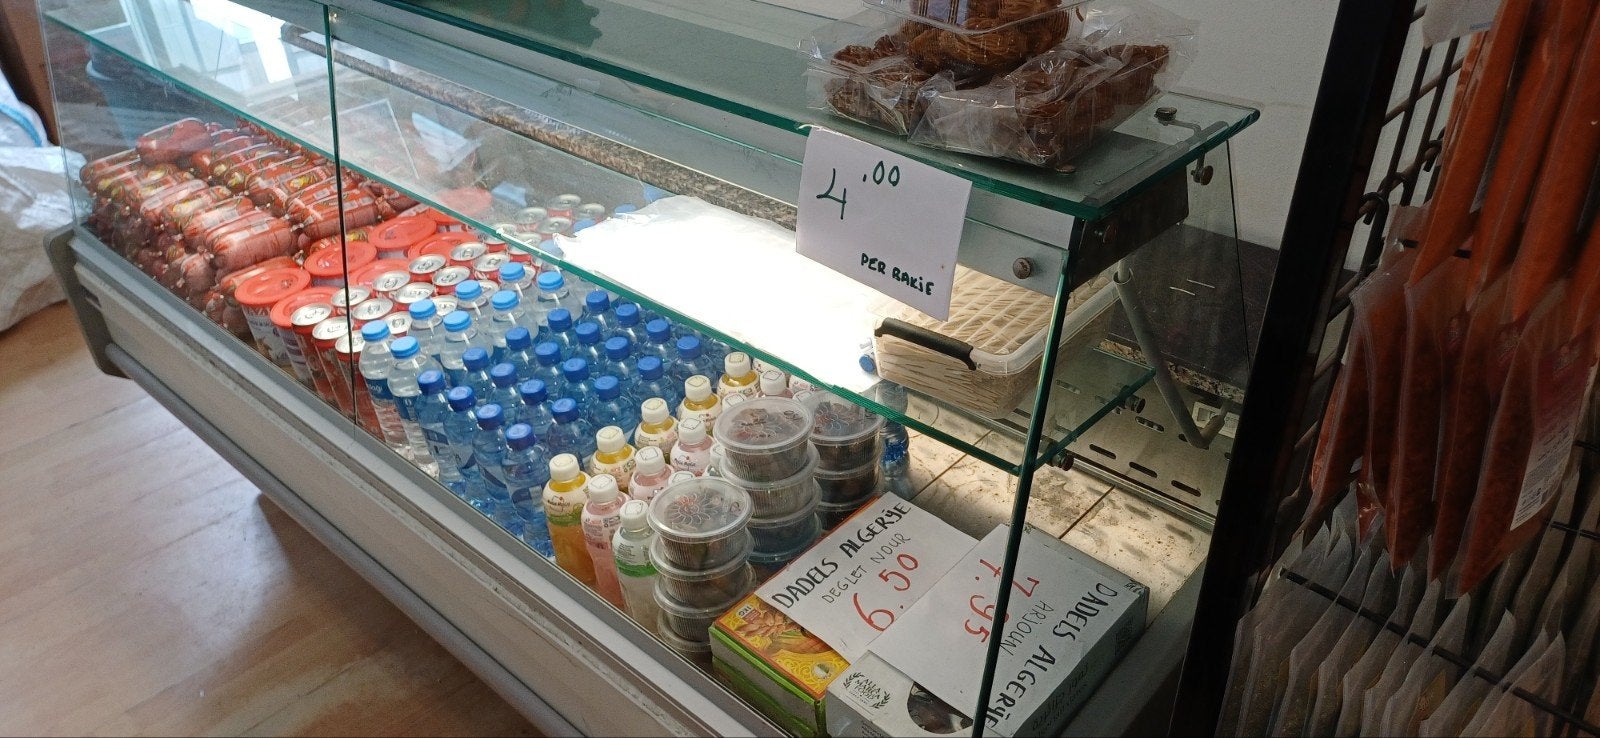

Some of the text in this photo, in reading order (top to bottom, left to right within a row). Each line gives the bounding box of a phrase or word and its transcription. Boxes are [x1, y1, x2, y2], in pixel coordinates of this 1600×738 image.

[861, 252, 886, 275] PER
[771, 557, 839, 609] DADELS
[821, 532, 911, 604] DEGLET NOUR
[1052, 582, 1118, 641] DADELS
